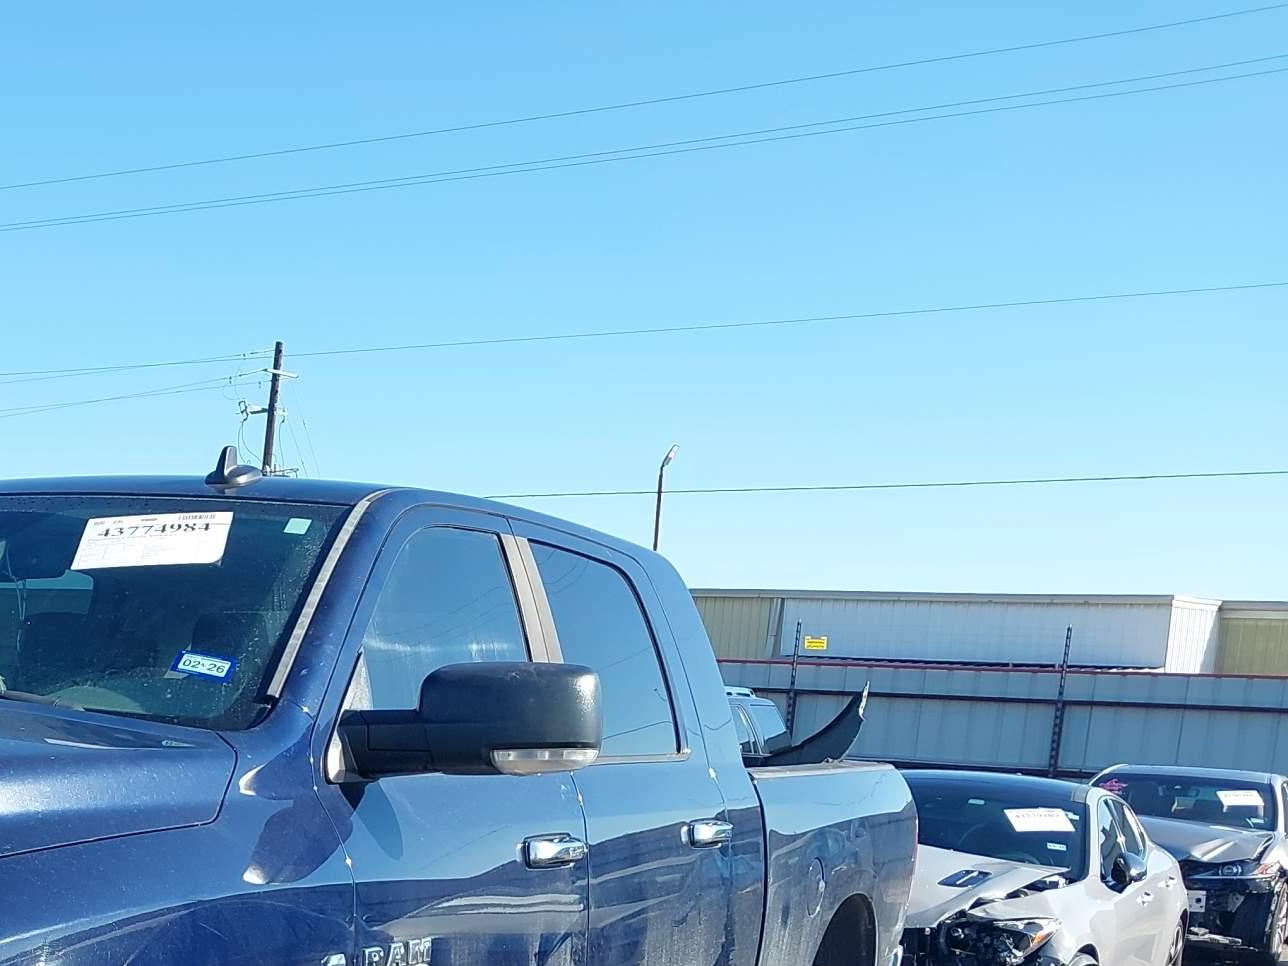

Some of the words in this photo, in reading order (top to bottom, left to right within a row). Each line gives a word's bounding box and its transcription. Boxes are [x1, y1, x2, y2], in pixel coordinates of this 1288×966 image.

[98, 522, 212, 537] 43774984
[182, 659, 201, 669] 02
[207, 663, 227, 674] 26
